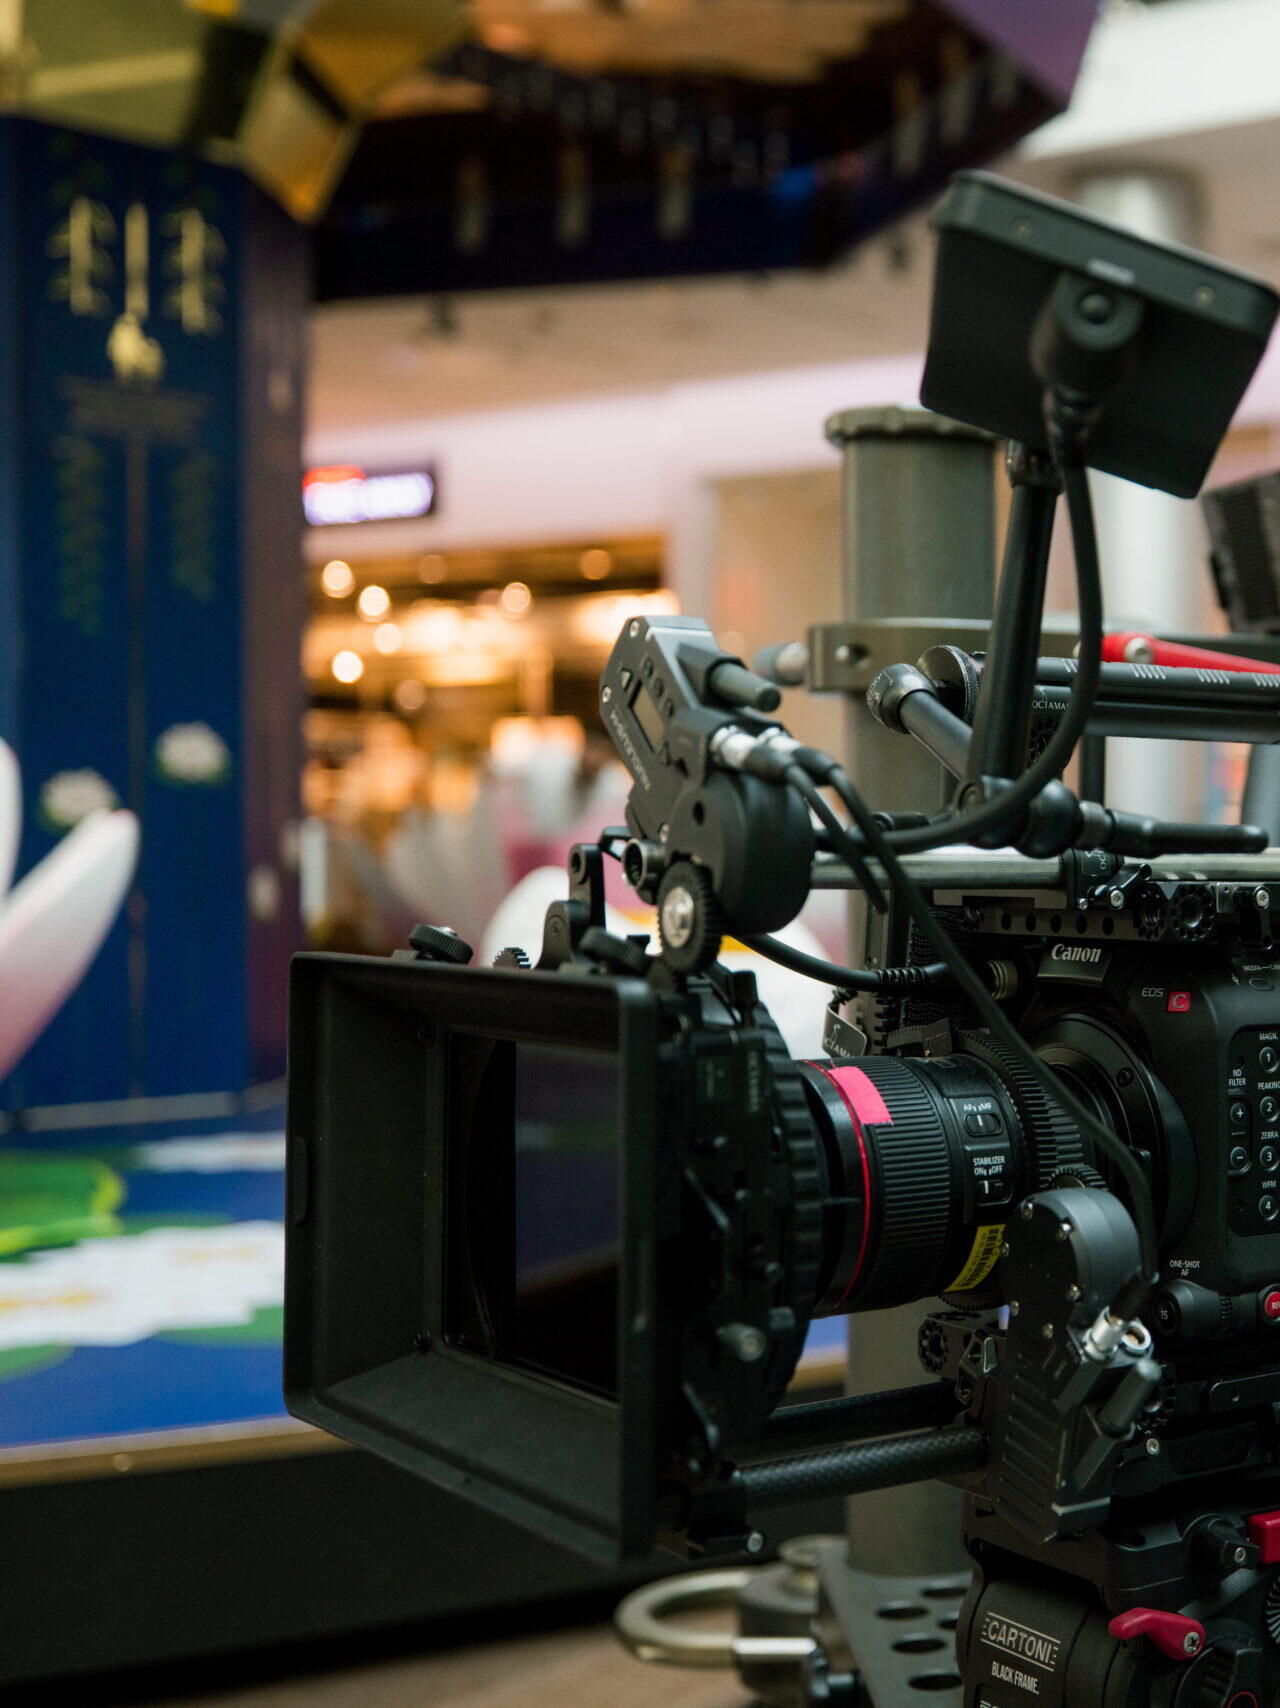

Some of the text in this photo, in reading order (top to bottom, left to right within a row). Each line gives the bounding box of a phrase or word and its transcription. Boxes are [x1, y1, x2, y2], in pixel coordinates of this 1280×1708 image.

[1051, 943, 1102, 963] Canon
[1142, 987, 1164, 997] EOS
[1171, 993, 1186, 1009] C
[1259, 1033, 1279, 1041] MAGN.
[1266, 1053, 1271, 1062] 1
[1232, 1069, 1242, 1077] ND
[1228, 1078, 1246, 1087] FILTER
[981, 1102, 993, 1110] MF
[1267, 1103, 1273, 1112] 2
[1260, 1132, 1278, 1140] ZEBRA
[973, 1156, 1005, 1166] STABILIZER
[1267, 1152, 1273, 1162] 3
[974, 1165, 1003, 1176] ON OFF
[1261, 1181, 1276, 1189] WFM
[1266, 1201, 1272, 1211] 4
[1169, 1260, 1200, 1269] ONE-SHOT
[1181, 1269, 1189, 1277] AF
[1160, 1309, 1168, 1320] 15
[987, 1620, 1052, 1664] CARTONI
[991, 1660, 1040, 1694] BLACK FRAME.
